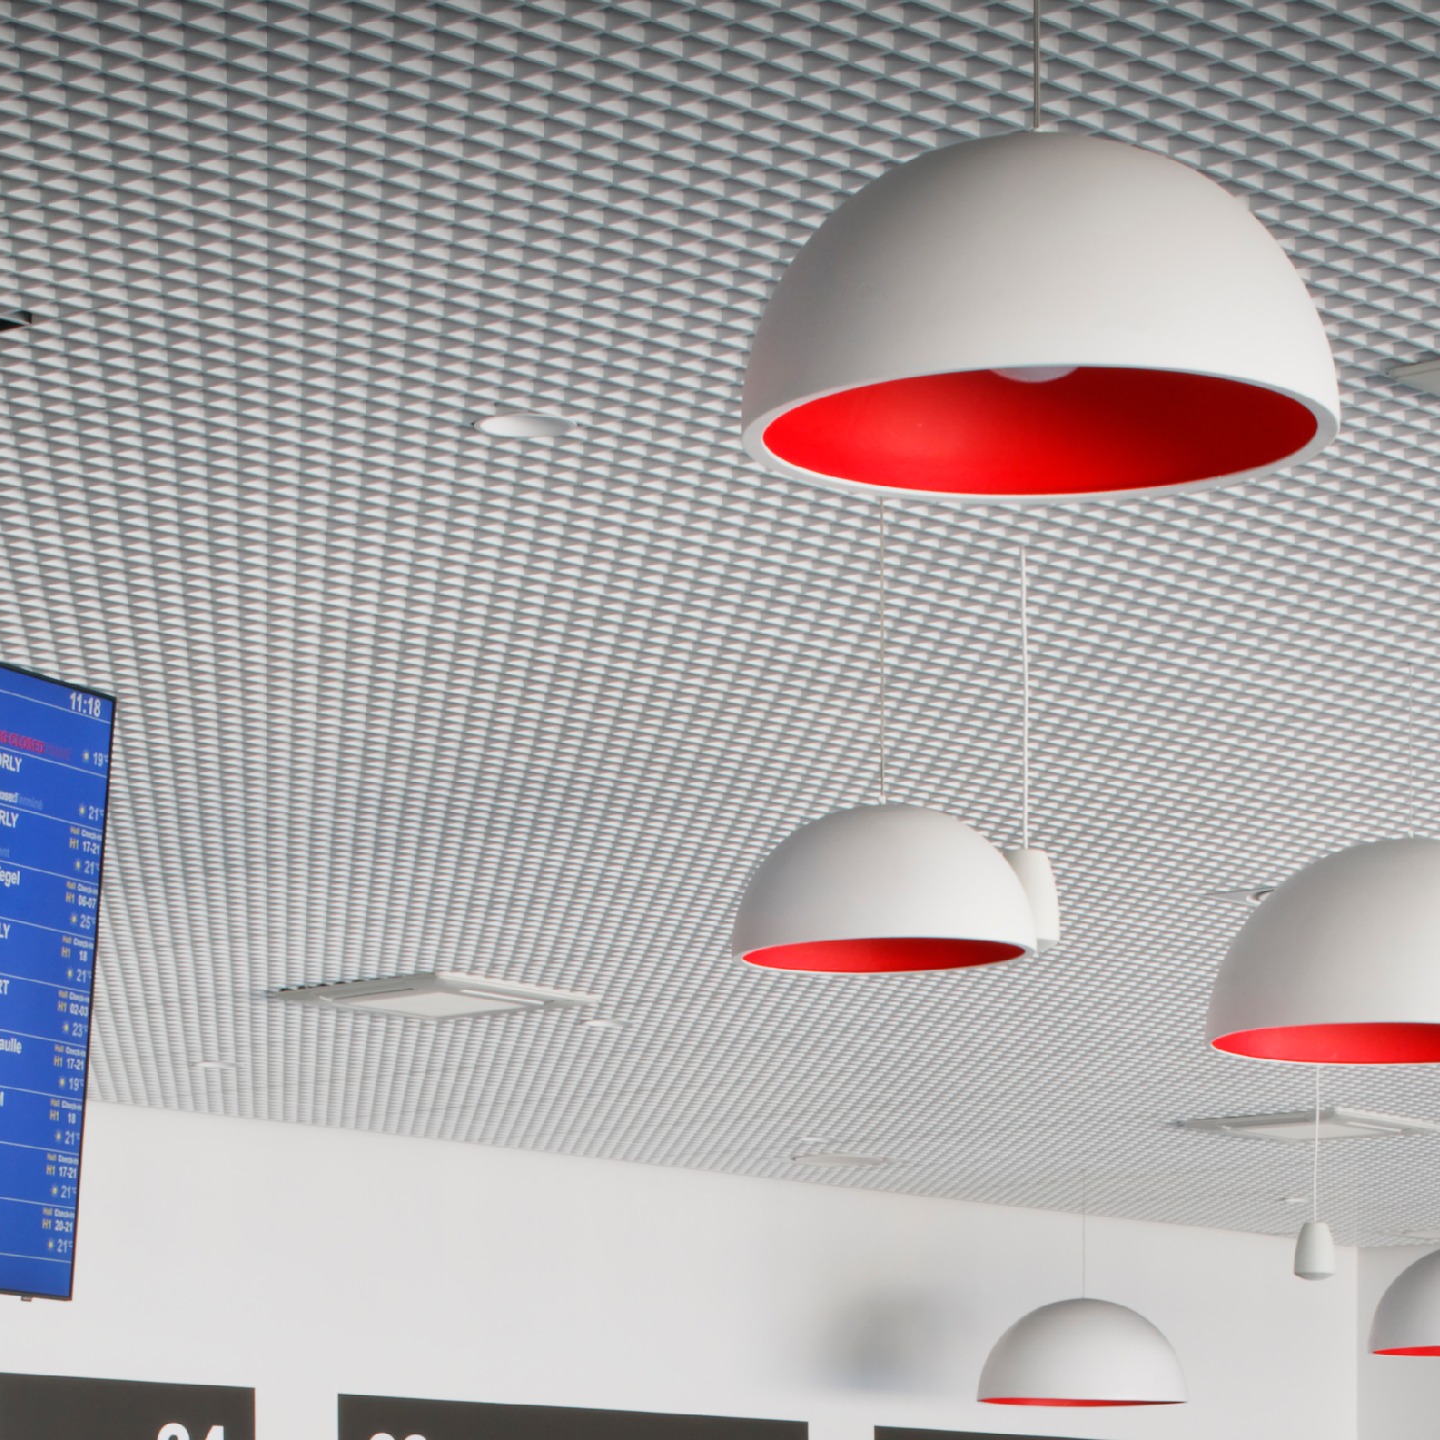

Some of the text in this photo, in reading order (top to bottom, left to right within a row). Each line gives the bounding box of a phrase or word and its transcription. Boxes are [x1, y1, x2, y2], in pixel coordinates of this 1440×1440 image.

[70, 692, 101, 717] 11:18
[10, 733, 45, 753] CLOSED
[69, 838, 99, 854] H1 17-21
[66, 892, 74, 903] H1
[62, 947, 87, 961] H1 18
[58, 1002, 66, 1012] H1
[54, 1056, 84, 1070] H1 17-21
[50, 1111, 76, 1124] H1 18
[46, 1165, 77, 1179] H1 17-21
[42, 1219, 51, 1229] H1
